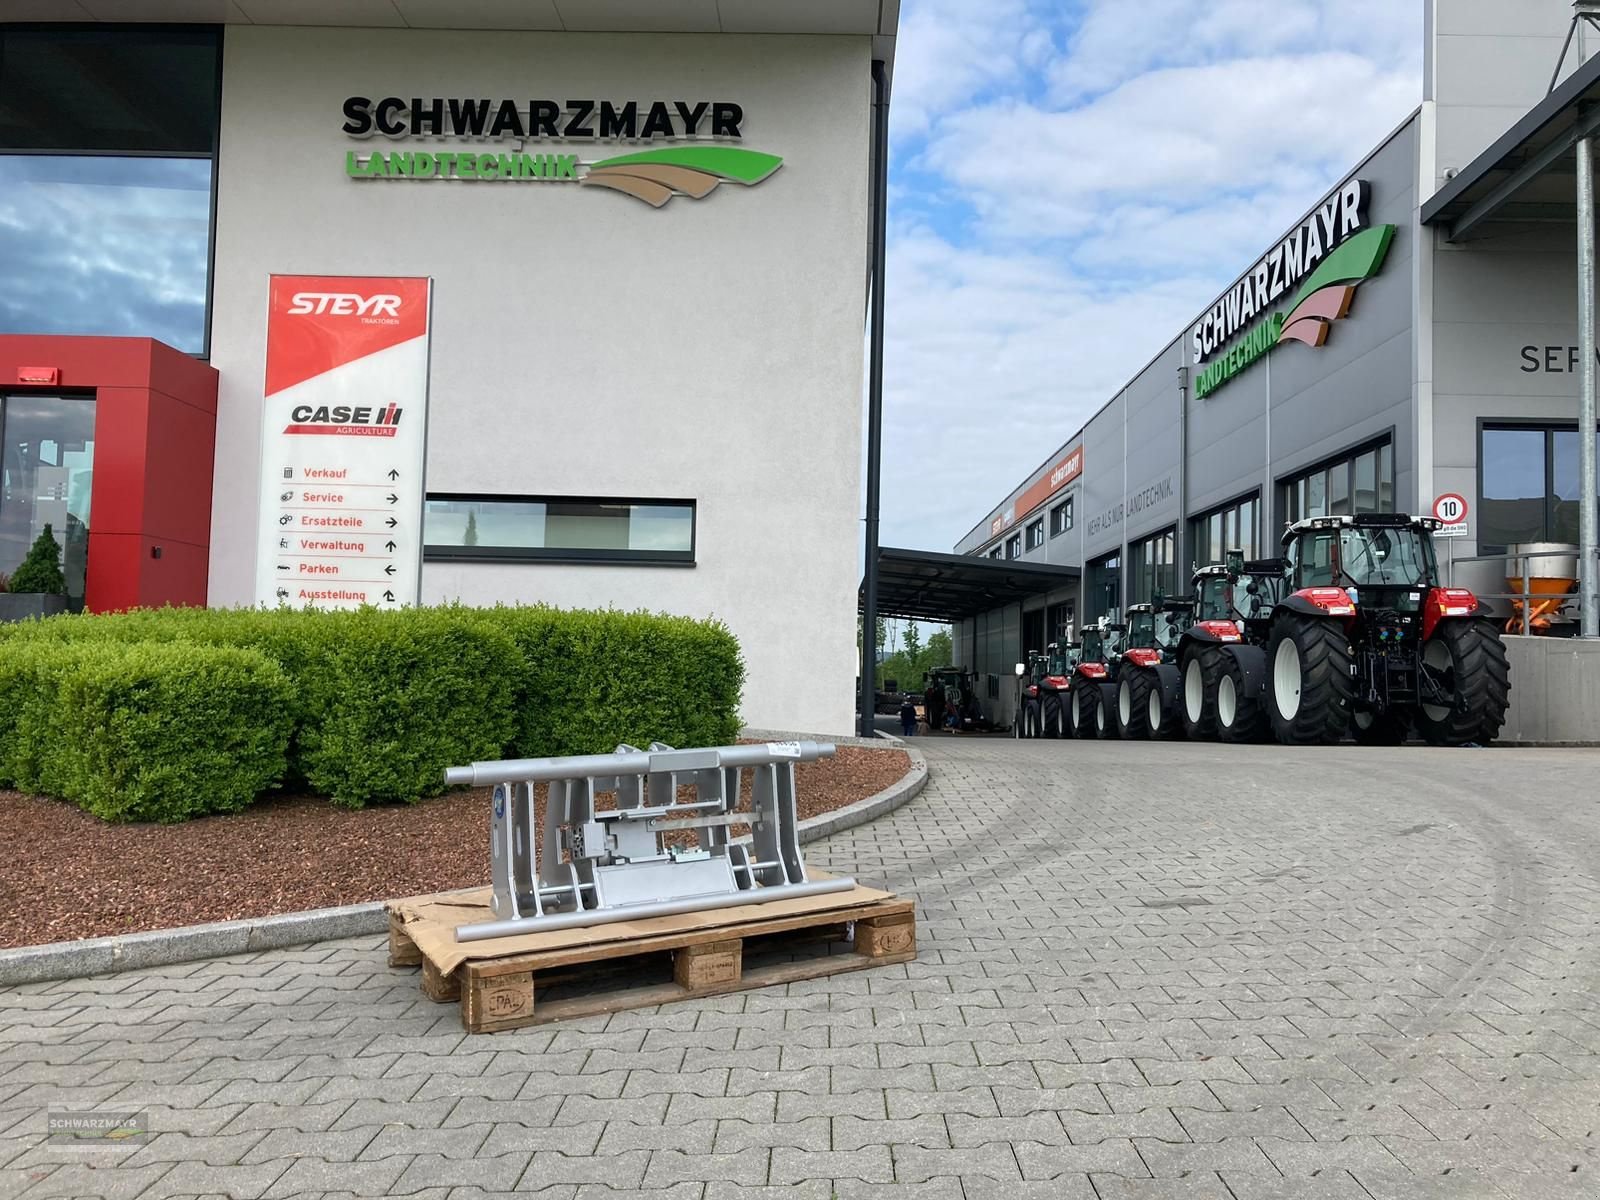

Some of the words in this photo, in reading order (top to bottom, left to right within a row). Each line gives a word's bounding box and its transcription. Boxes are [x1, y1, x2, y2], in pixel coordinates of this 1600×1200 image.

[341, 97, 744, 140] SCHWARZMAYR
[346, 151, 579, 180] LANDTECHNIK
[1193, 179, 1363, 364] SCHWARZMAYR
[287, 292, 402, 317] STEYR
[361, 317, 400, 326] TRAKTOREN
[1194, 314, 1281, 398] LANDTECHNIK
[291, 405, 372, 424] CASE
[336, 427, 393, 437] AGRICULTURE
[304, 467, 348, 479] Verkauf
[303, 492, 344, 503] Service
[1442, 501, 1457, 517] 10
[301, 516, 363, 528] Ersatzteile
[300, 539, 365, 553] Verwaltung
[299, 563, 339, 574] Parken
[299, 589, 366, 600] Ausstellung
